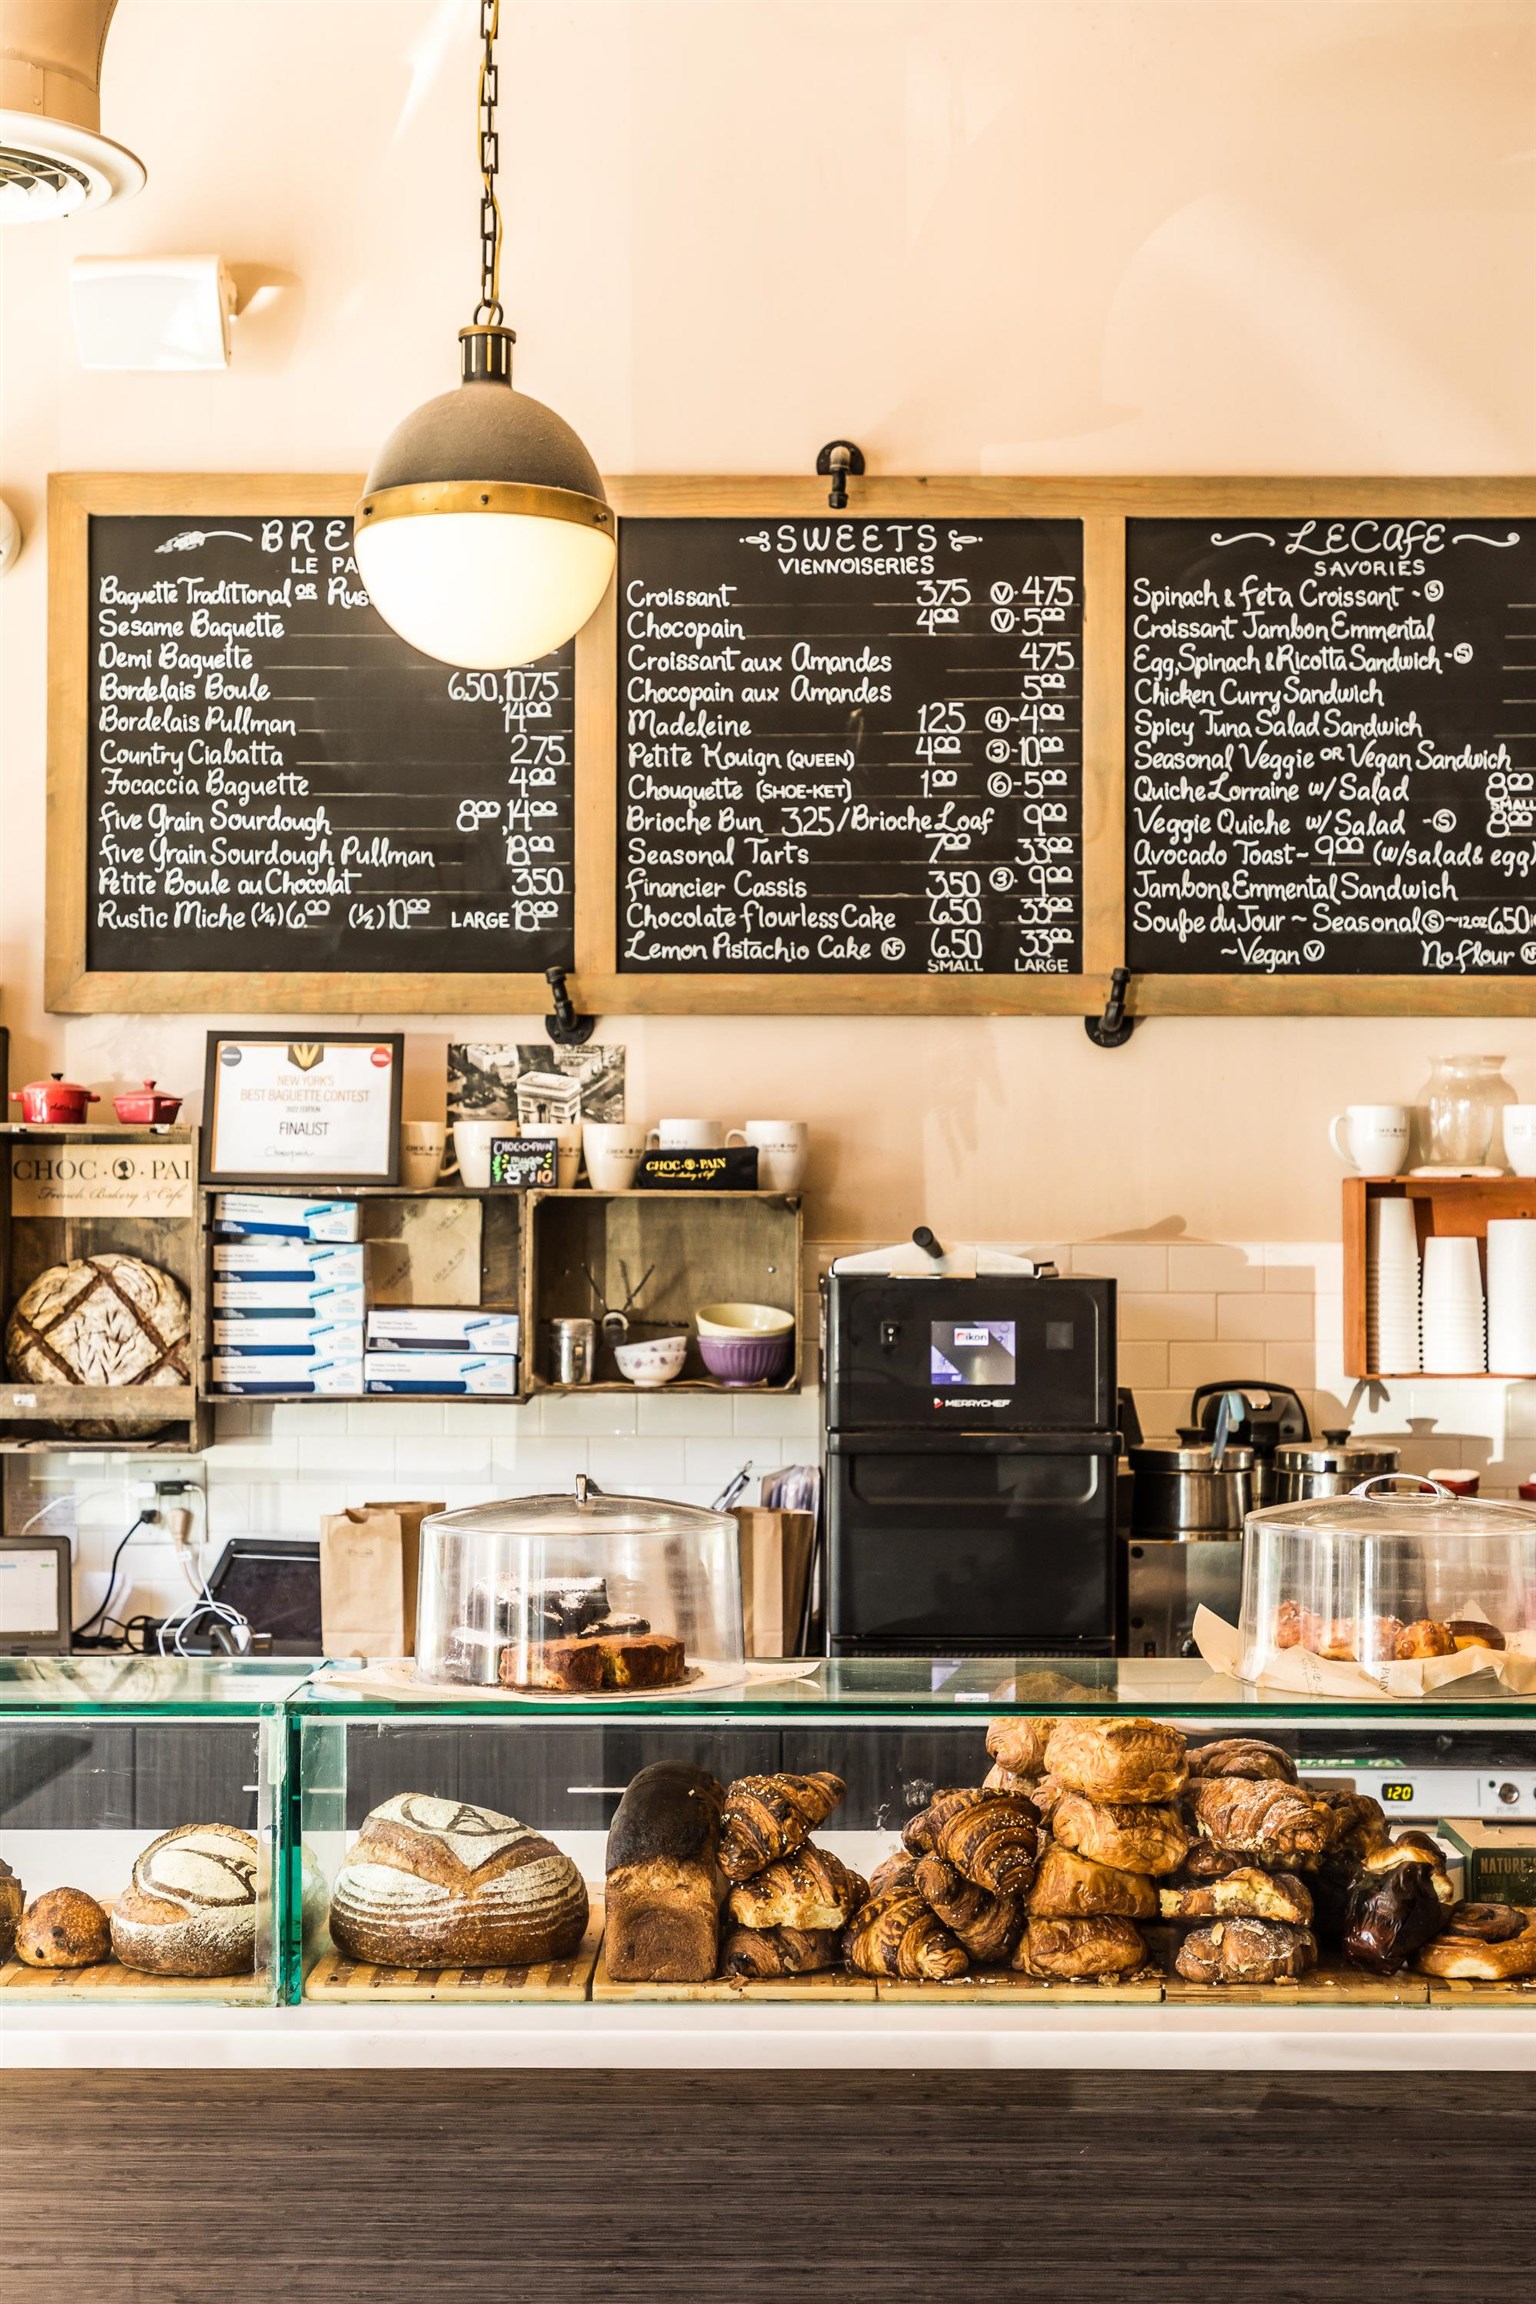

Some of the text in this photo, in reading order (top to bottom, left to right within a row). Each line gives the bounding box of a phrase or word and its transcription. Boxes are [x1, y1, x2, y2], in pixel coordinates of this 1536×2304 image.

[262, 520, 349, 553] BRE
[777, 525, 937, 553] SWEETS
[292, 556, 359, 575] LE PA
[778, 555, 934, 575] VIENNOISERIES
[1315, 559, 1425, 577] SAVORIES
[99, 575, 178, 615] Baguette
[295, 583, 318, 600] OR
[328, 575, 371, 609] Rus
[627, 580, 737, 608] Croissant
[1134, 578, 1404, 614] Spinach & Croissant
[99, 608, 284, 648] Sesame Baguette
[627, 612, 745, 650] Chocopain
[1134, 611, 1435, 643] Croissant Jambon Emmental
[99, 641, 253, 679] Demi Baguette
[628, 642, 892, 674] Croissant aux Amandes
[1276, 644, 1347, 674] Ricotta
[1349, 644, 1443, 674] Sandwich
[100, 673, 270, 702] Bordelais Boule
[628, 677, 733, 711] Chocopain
[742, 687, 779, 702] aux
[791, 675, 892, 705] Amandes
[1135, 676, 1384, 716] Chicken Curry Sandwich
[99, 706, 200, 733] Bordelais
[205, 706, 296, 736] Pullman
[628, 709, 751, 738] Madeleine
[1135, 709, 1423, 744] Spicy Tuna Salad Sandwich
[100, 738, 283, 775] Country Ciabatta
[628, 742, 692, 768] Petite
[701, 742, 782, 776] Kouign
[787, 750, 854, 771] (QUEEN)
[1135, 737, 1512, 780] Seasonal Veggie OR Vegan Sandwich
[101, 767, 199, 795] Focaccia
[206, 768, 308, 806] Baguette
[628, 774, 743, 809] Chouquette
[1134, 771, 1409, 803] Quiche Lorraine w/ Salad
[148, 799, 332, 841] Grain Sourdough
[627, 805, 711, 833] Brioche
[718, 807, 763, 833] Bun
[934, 802, 994, 834] Loaf
[1134, 805, 1405, 840] Veggie Quiche w/ Salad
[149, 837, 207, 873] Grain
[210, 836, 335, 875] Sourdough
[341, 836, 435, 867] Pullman
[628, 837, 734, 866] Seasonal
[744, 838, 808, 864] Tarts
[1134, 838, 1227, 865] Avocado
[99, 866, 362, 896] Petite Boule au Chocolat
[734, 870, 807, 898] Cassis
[1134, 869, 1222, 901] Jambon
[1233, 869, 1341, 905] Emmental
[1341, 871, 1458, 901] Sandwich
[98, 900, 168, 929] Rustic
[174, 901, 245, 930] Miche
[452, 911, 510, 929] LARGE
[627, 898, 736, 929] Chocolate
[841, 904, 895, 930] Cake
[1210, 904, 1236, 933] du
[1237, 905, 1285, 932] Jour
[1313, 903, 1423, 935] Seasonal
[625, 930, 708, 960] Lemon
[713, 927, 809, 962] Pistachio
[818, 935, 870, 959] Cake
[1422, 940, 1453, 969] No
[928, 959, 1068, 972] SMALL LARGE
[240, 1089, 370, 1102] BEST BAGUETTE CONTEST
[278, 1076, 334, 1086] NEW YORK'S
[279, 1122, 329, 1136] FINALIST
[13, 1160, 192, 1180] CHOC PAI
[646, 1158, 726, 1171] CHOC PAIN
[945, 1399, 1011, 1407] MERRYCHEF
[1386, 1786, 1411, 1800] 120
